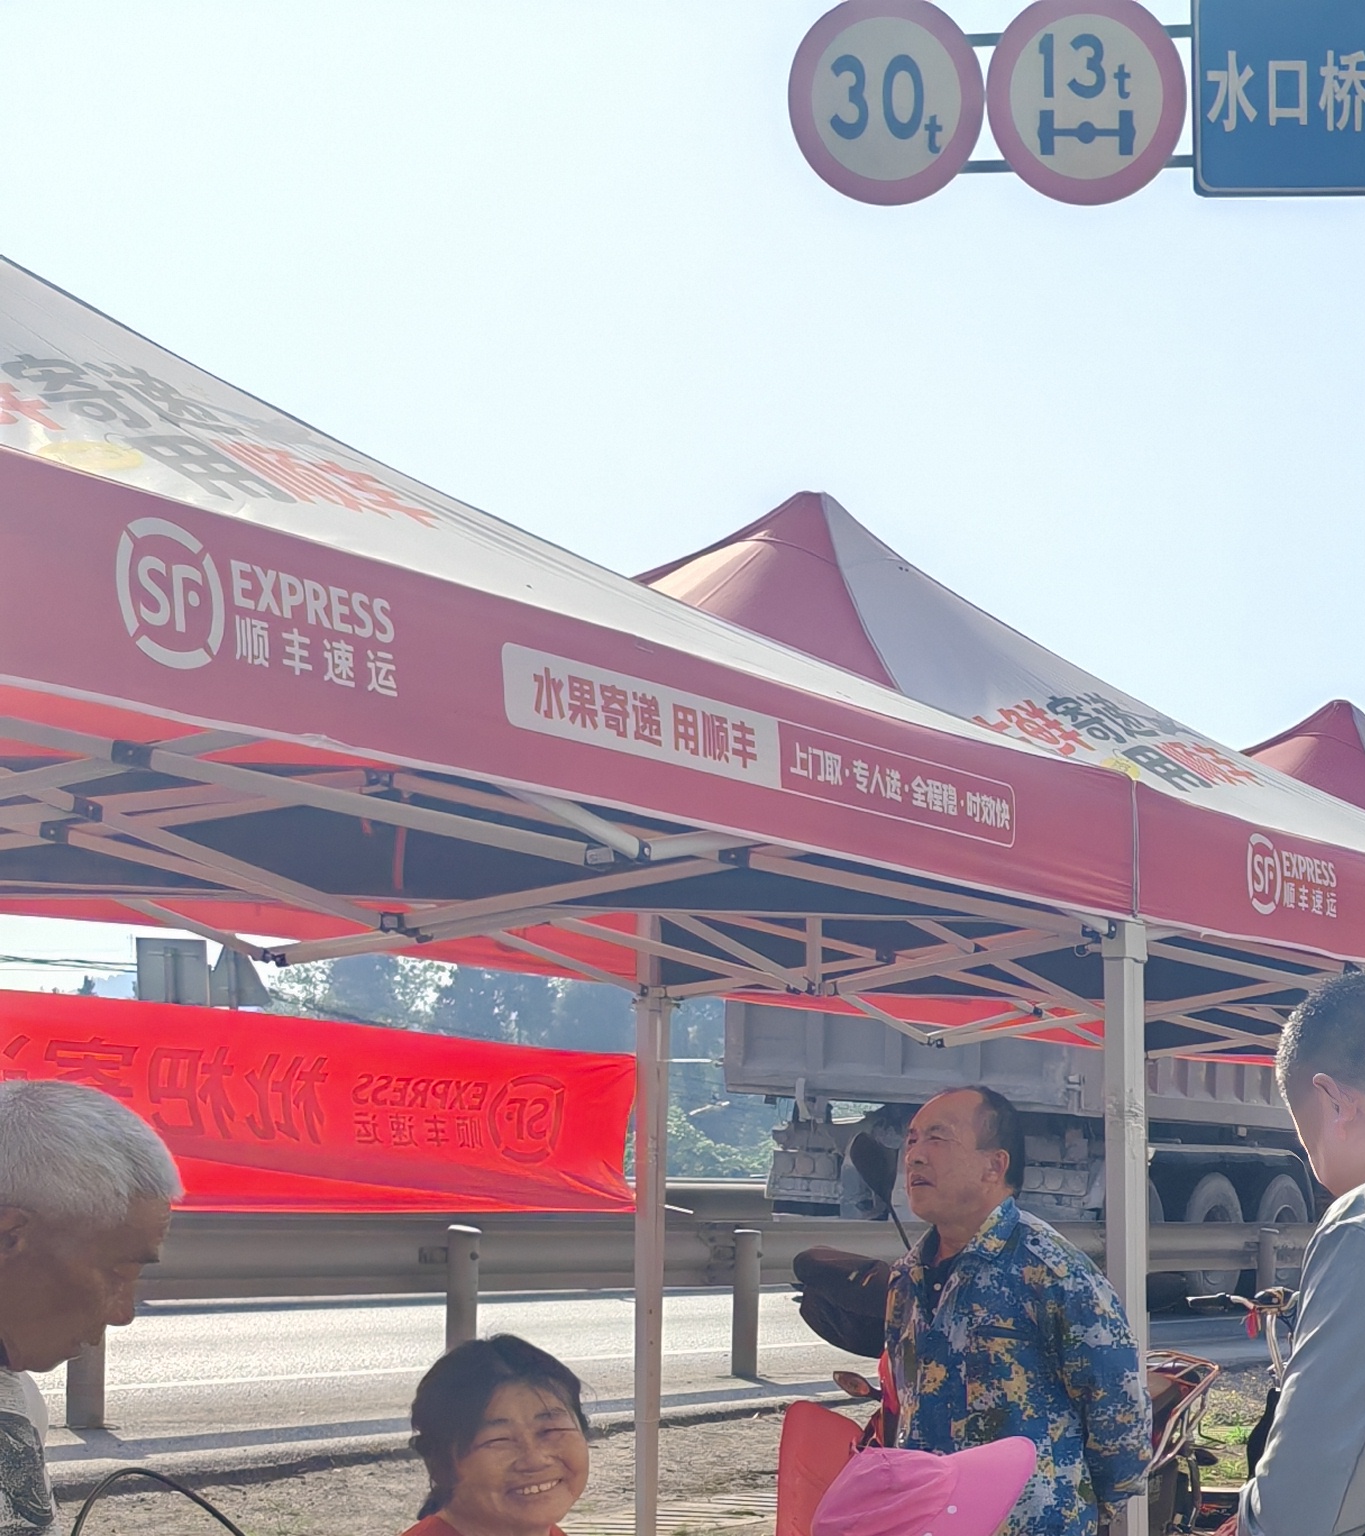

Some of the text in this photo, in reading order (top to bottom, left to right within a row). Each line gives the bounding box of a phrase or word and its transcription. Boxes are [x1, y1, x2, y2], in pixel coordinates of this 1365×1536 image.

[829, 53, 943, 154] 30t
[1037, 32, 1132, 100] 13t
[230, 558, 396, 645] EXPRESS
[234, 616, 399, 697] 顺丰速运
[532, 666, 759, 770] 水果寄递 用顺丰
[1281, 849, 1338, 889] EXPRESS
[1281, 884, 1339, 919] 顺丰速运
